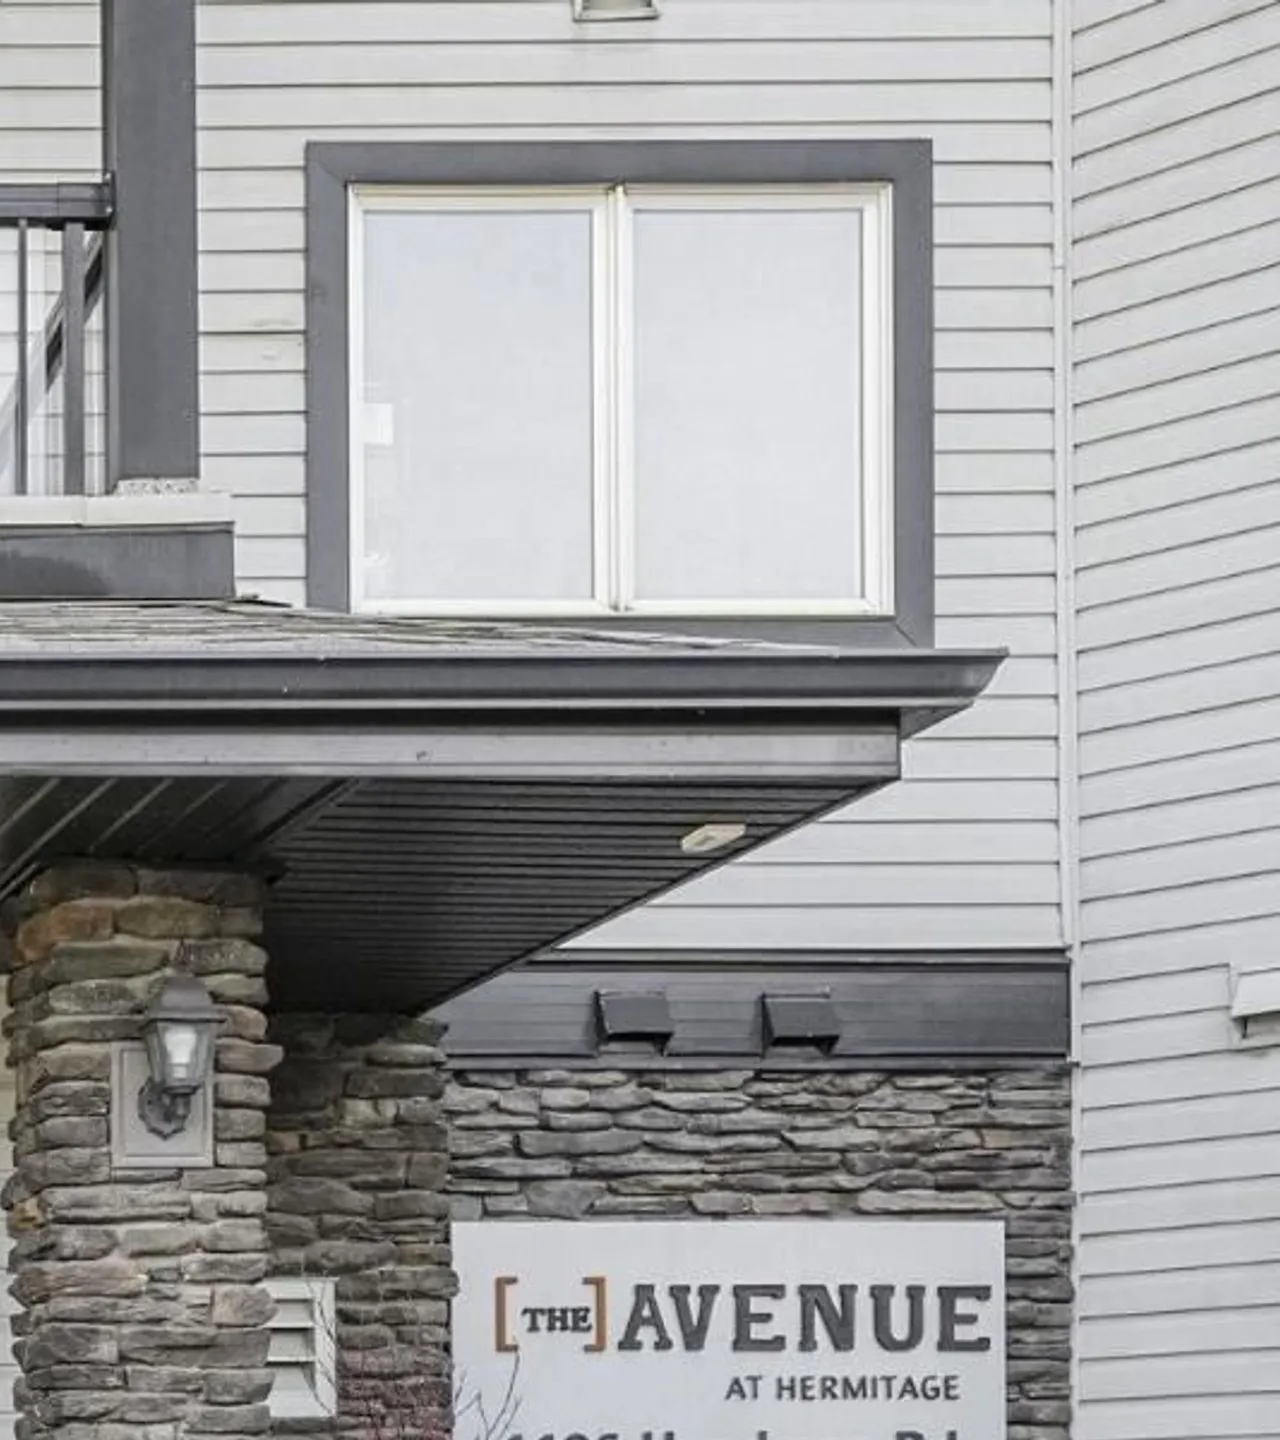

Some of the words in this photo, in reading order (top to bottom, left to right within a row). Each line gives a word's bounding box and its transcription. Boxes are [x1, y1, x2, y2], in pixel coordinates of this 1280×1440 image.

[617, 1284, 992, 1352] AVENUE
[724, 1375, 763, 1401] AT
[775, 1375, 960, 1401] HERMITAGE
